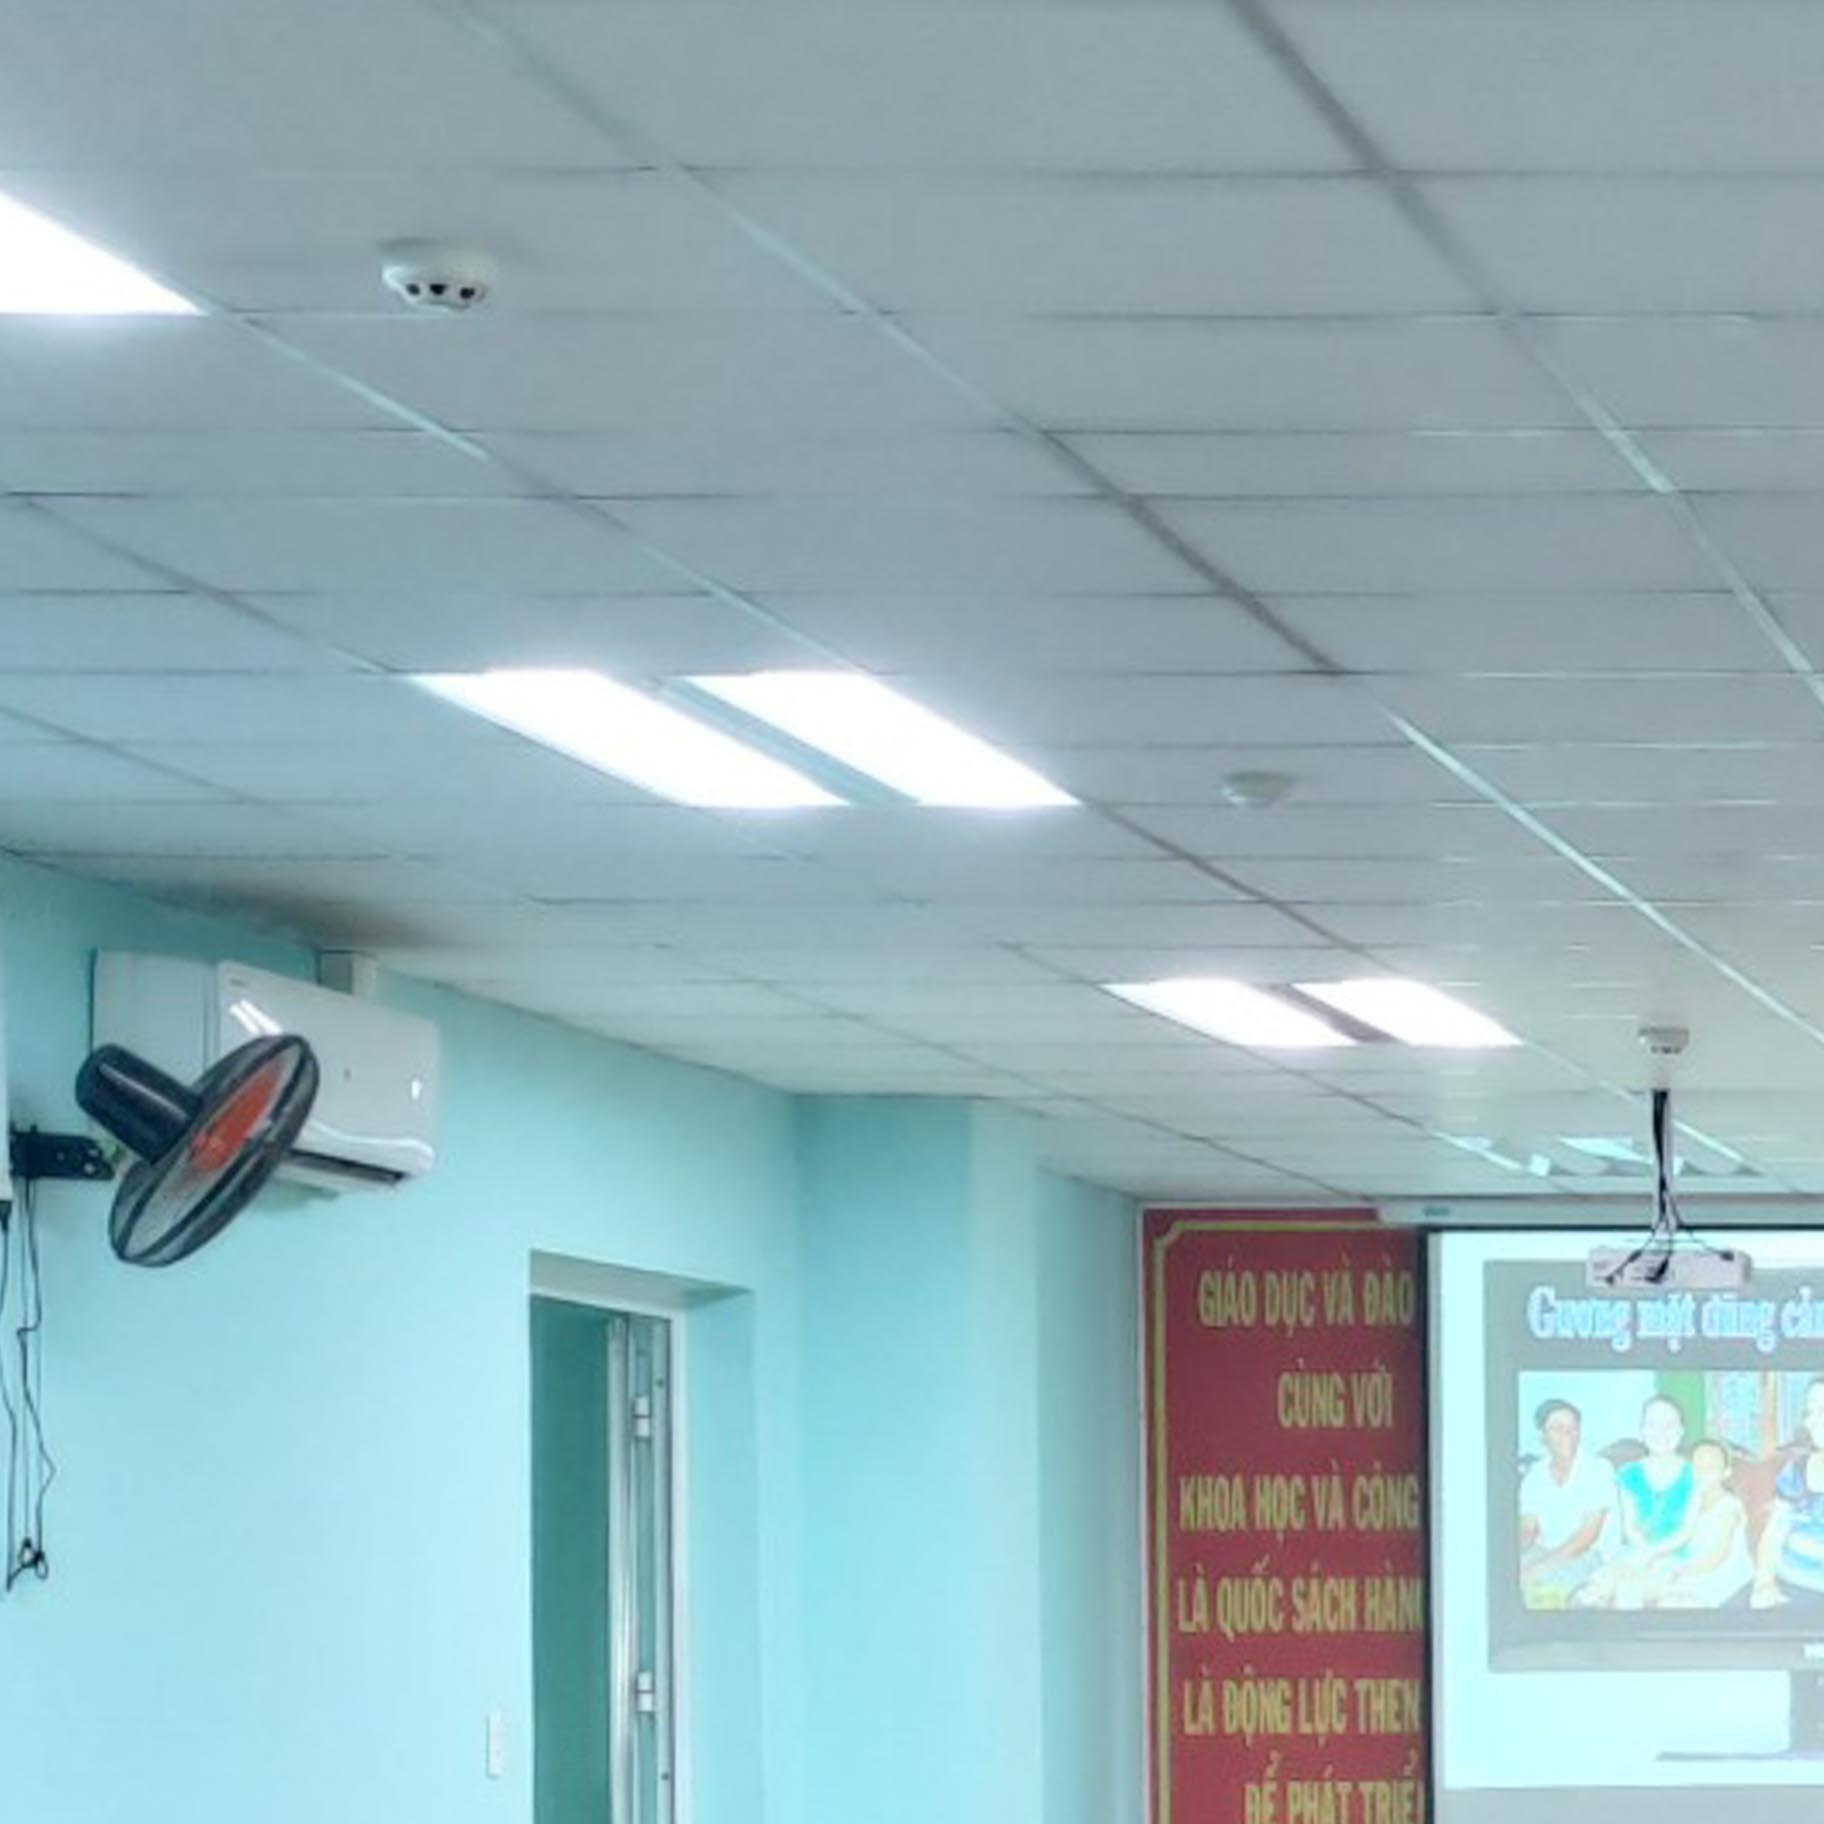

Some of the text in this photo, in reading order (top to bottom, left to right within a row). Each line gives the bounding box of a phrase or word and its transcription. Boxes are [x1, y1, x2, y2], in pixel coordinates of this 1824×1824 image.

[1199, 1254, 1416, 1338] GIÁO DỤC VÀ ĐÀO
[1527, 1286, 1632, 1353] Gương
[1278, 1357, 1394, 1428] CÙNG VỚI
[1179, 1459, 1421, 1542] KHOA HỌC VÀ CÔNG
[1177, 1563, 1212, 1632] LÀ
[1216, 1554, 1284, 1642] QUỐC
[1291, 1562, 1357, 1632] SÁCH
[1183, 1664, 1421, 1747] LÀ ĐỘNG LỰC THEN
